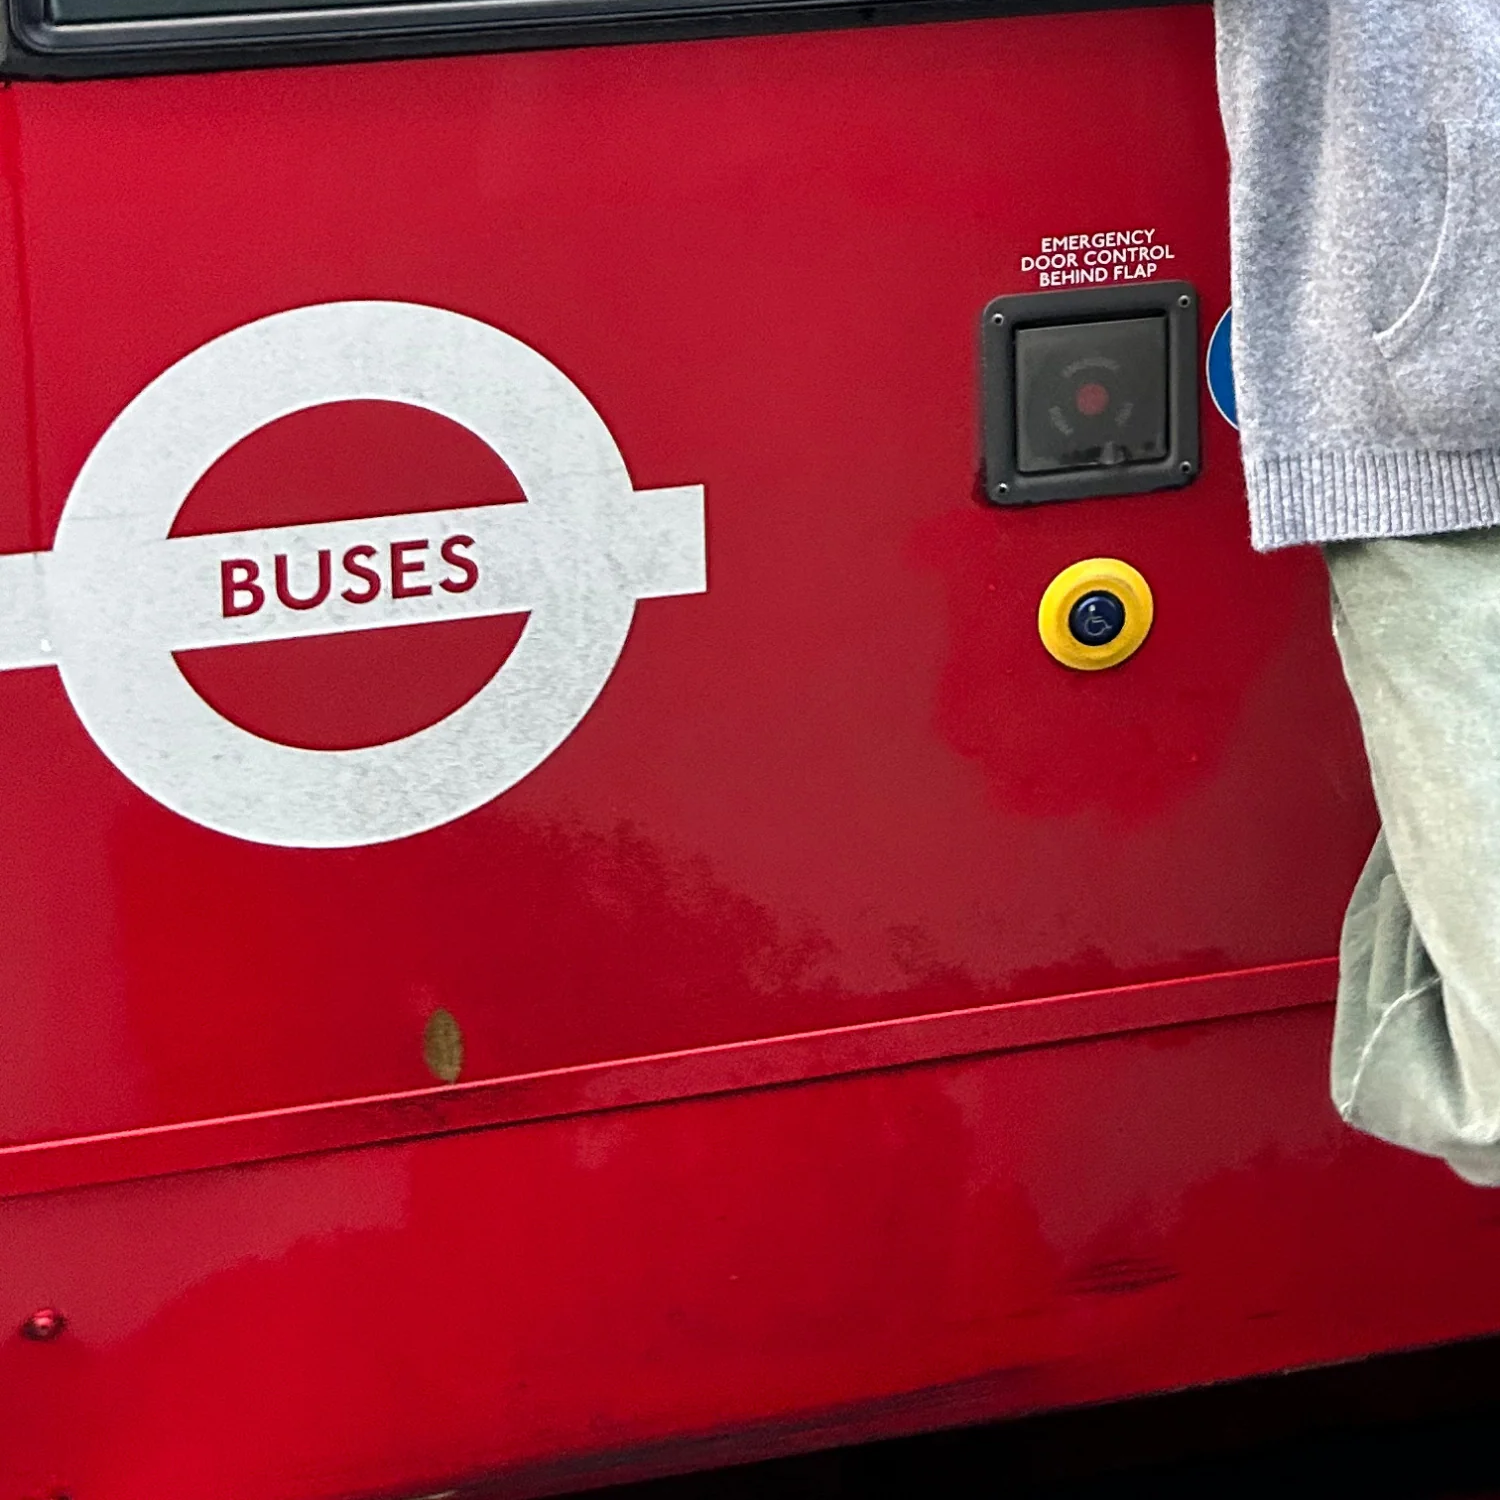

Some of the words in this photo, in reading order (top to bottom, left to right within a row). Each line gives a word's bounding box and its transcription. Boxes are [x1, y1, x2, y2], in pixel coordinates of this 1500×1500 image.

[1041, 228, 1156, 253] EMERGENCY
[1021, 253, 1078, 272] DOOR
[1083, 244, 1176, 266] CONTROL
[1039, 267, 1108, 287] BEHIND
[1113, 262, 1158, 280] FLAP
[220, 534, 479, 619] BUSES
